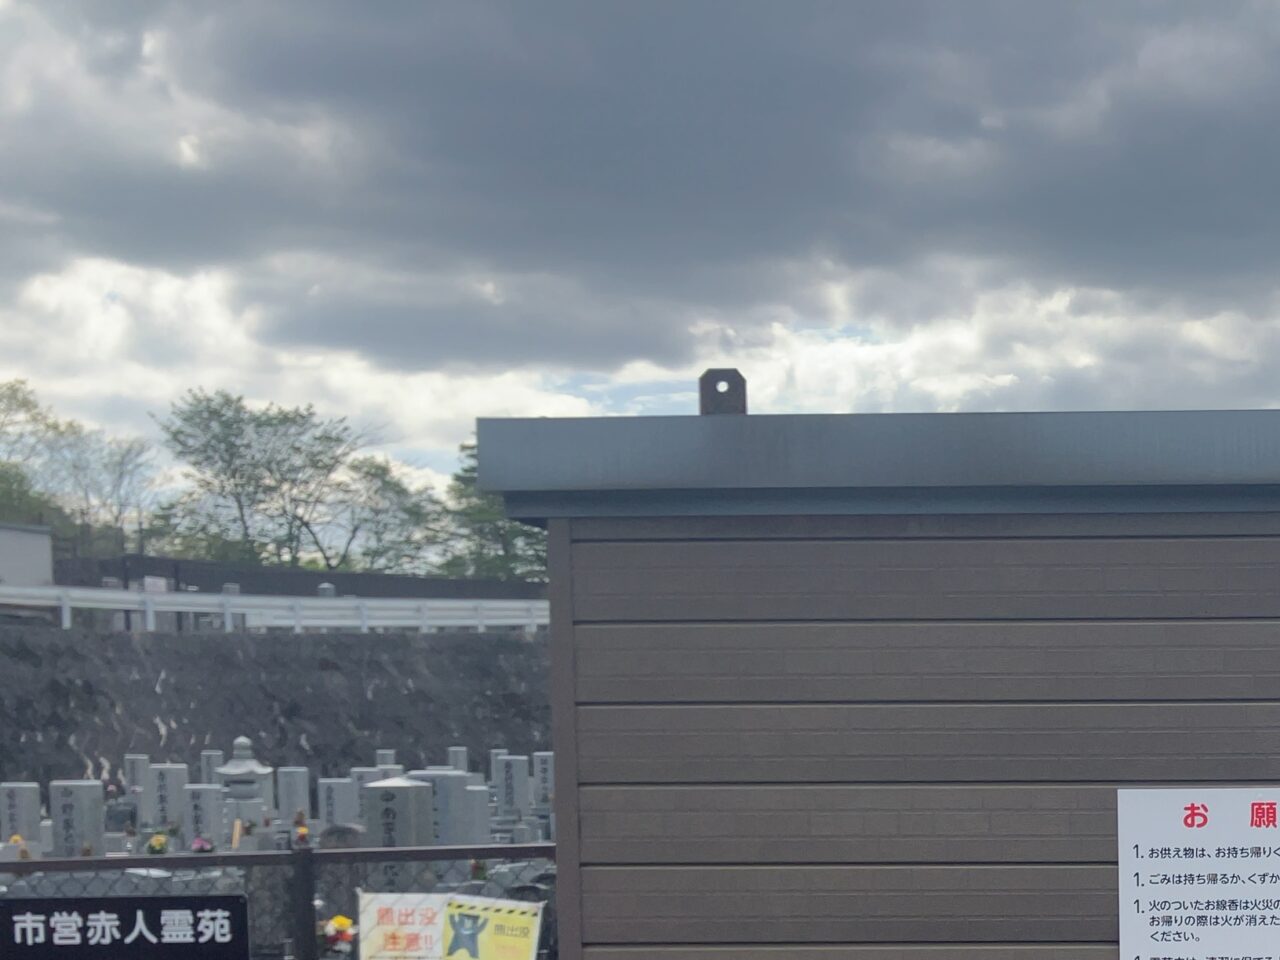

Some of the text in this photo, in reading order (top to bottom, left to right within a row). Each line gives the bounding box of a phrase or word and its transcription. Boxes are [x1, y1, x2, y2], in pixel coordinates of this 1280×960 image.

[12, 908, 232, 946] 市営赤人霊苑
[1149, 930, 1200, 943] ください。
